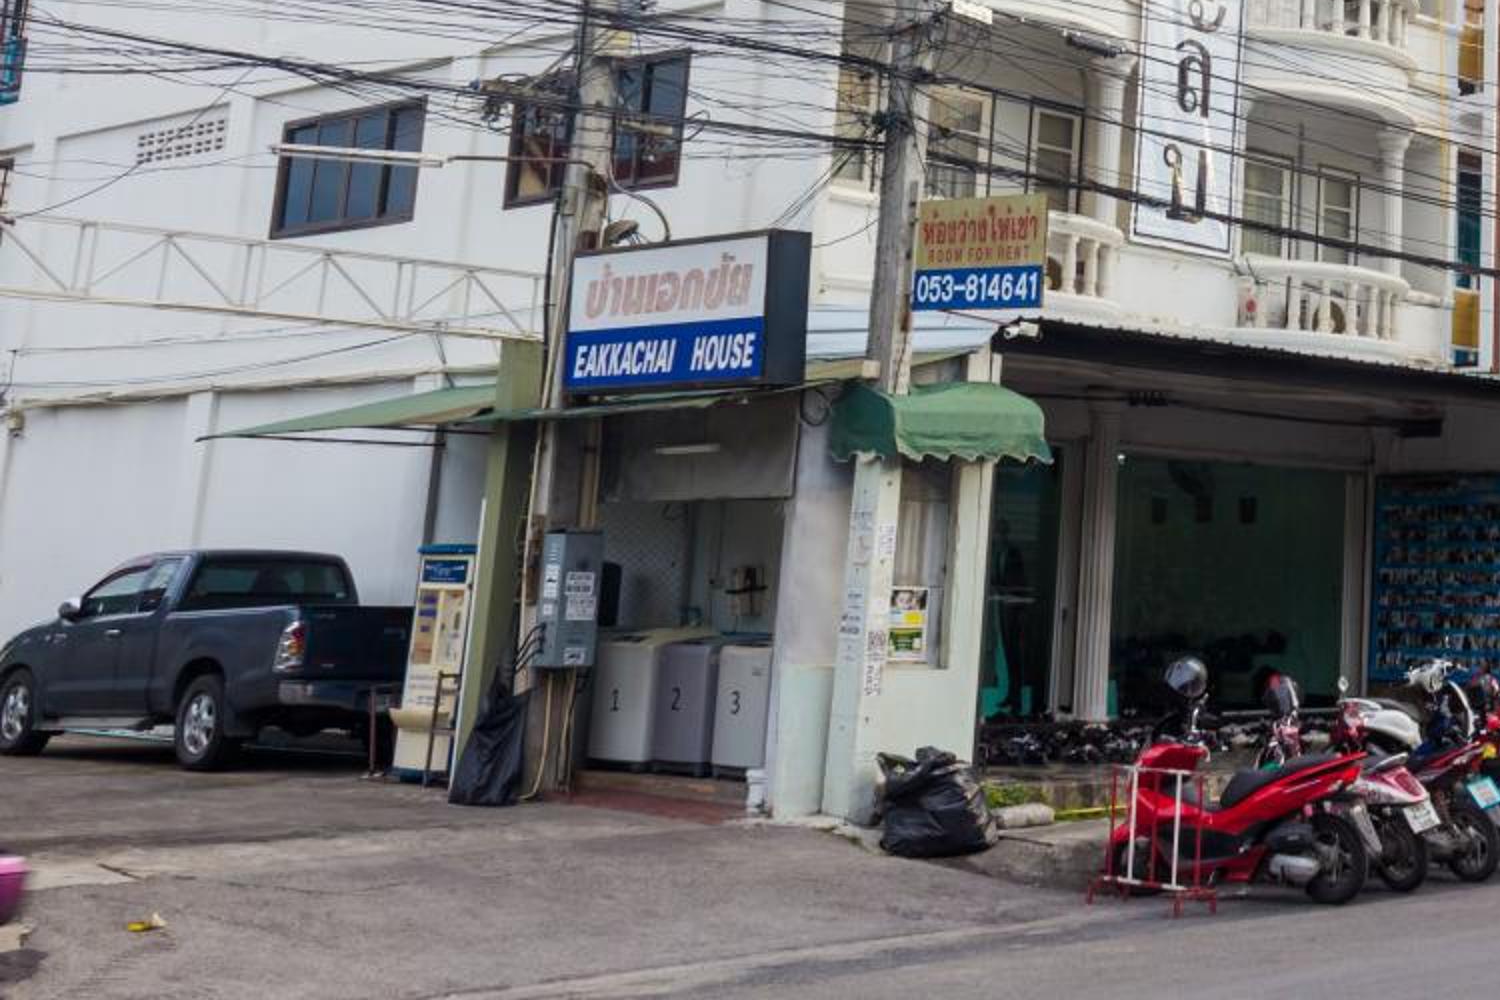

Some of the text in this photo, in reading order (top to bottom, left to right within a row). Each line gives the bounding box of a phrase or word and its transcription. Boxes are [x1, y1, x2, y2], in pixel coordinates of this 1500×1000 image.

[916, 271, 1038, 303] 053-814641
[572, 332, 756, 379] EAKKACHAI HOUSE
[609, 688, 621, 712] 1
[671, 686, 682, 711] 2
[729, 690, 741, 715] 3
